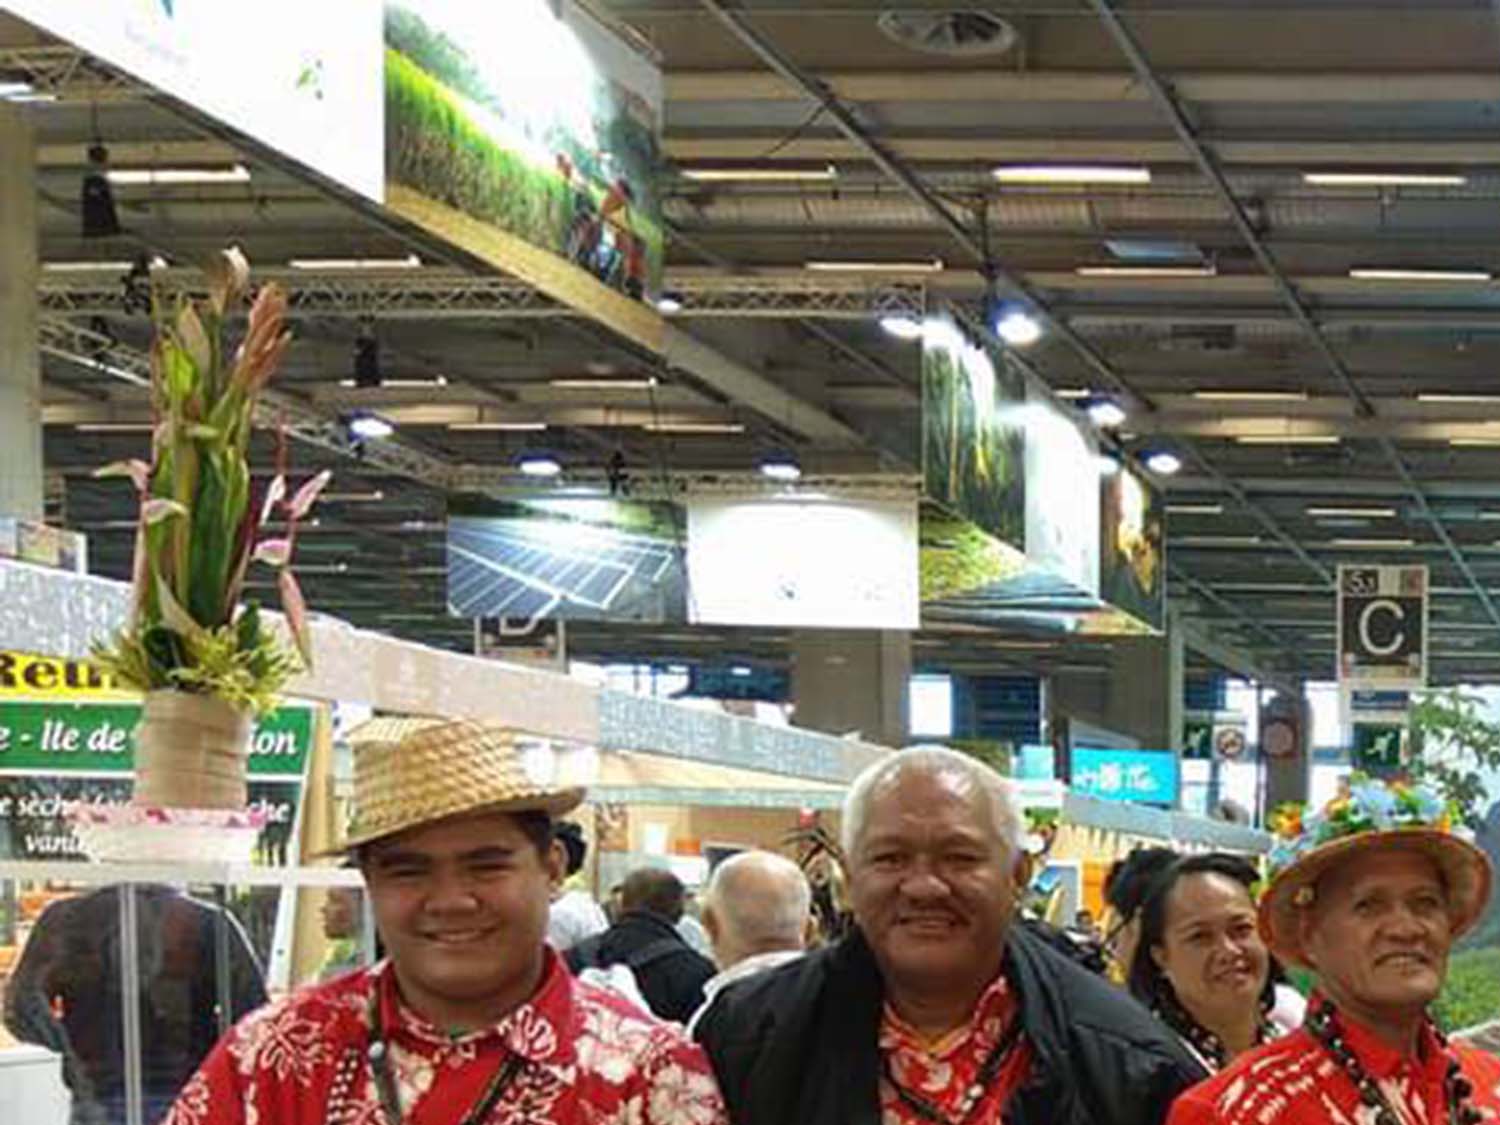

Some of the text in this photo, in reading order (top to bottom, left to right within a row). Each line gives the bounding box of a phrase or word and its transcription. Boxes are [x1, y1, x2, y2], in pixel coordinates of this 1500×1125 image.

[1359, 600, 1404, 655] C
[88, 722, 126, 752] de
[249, 723, 297, 754] ion
